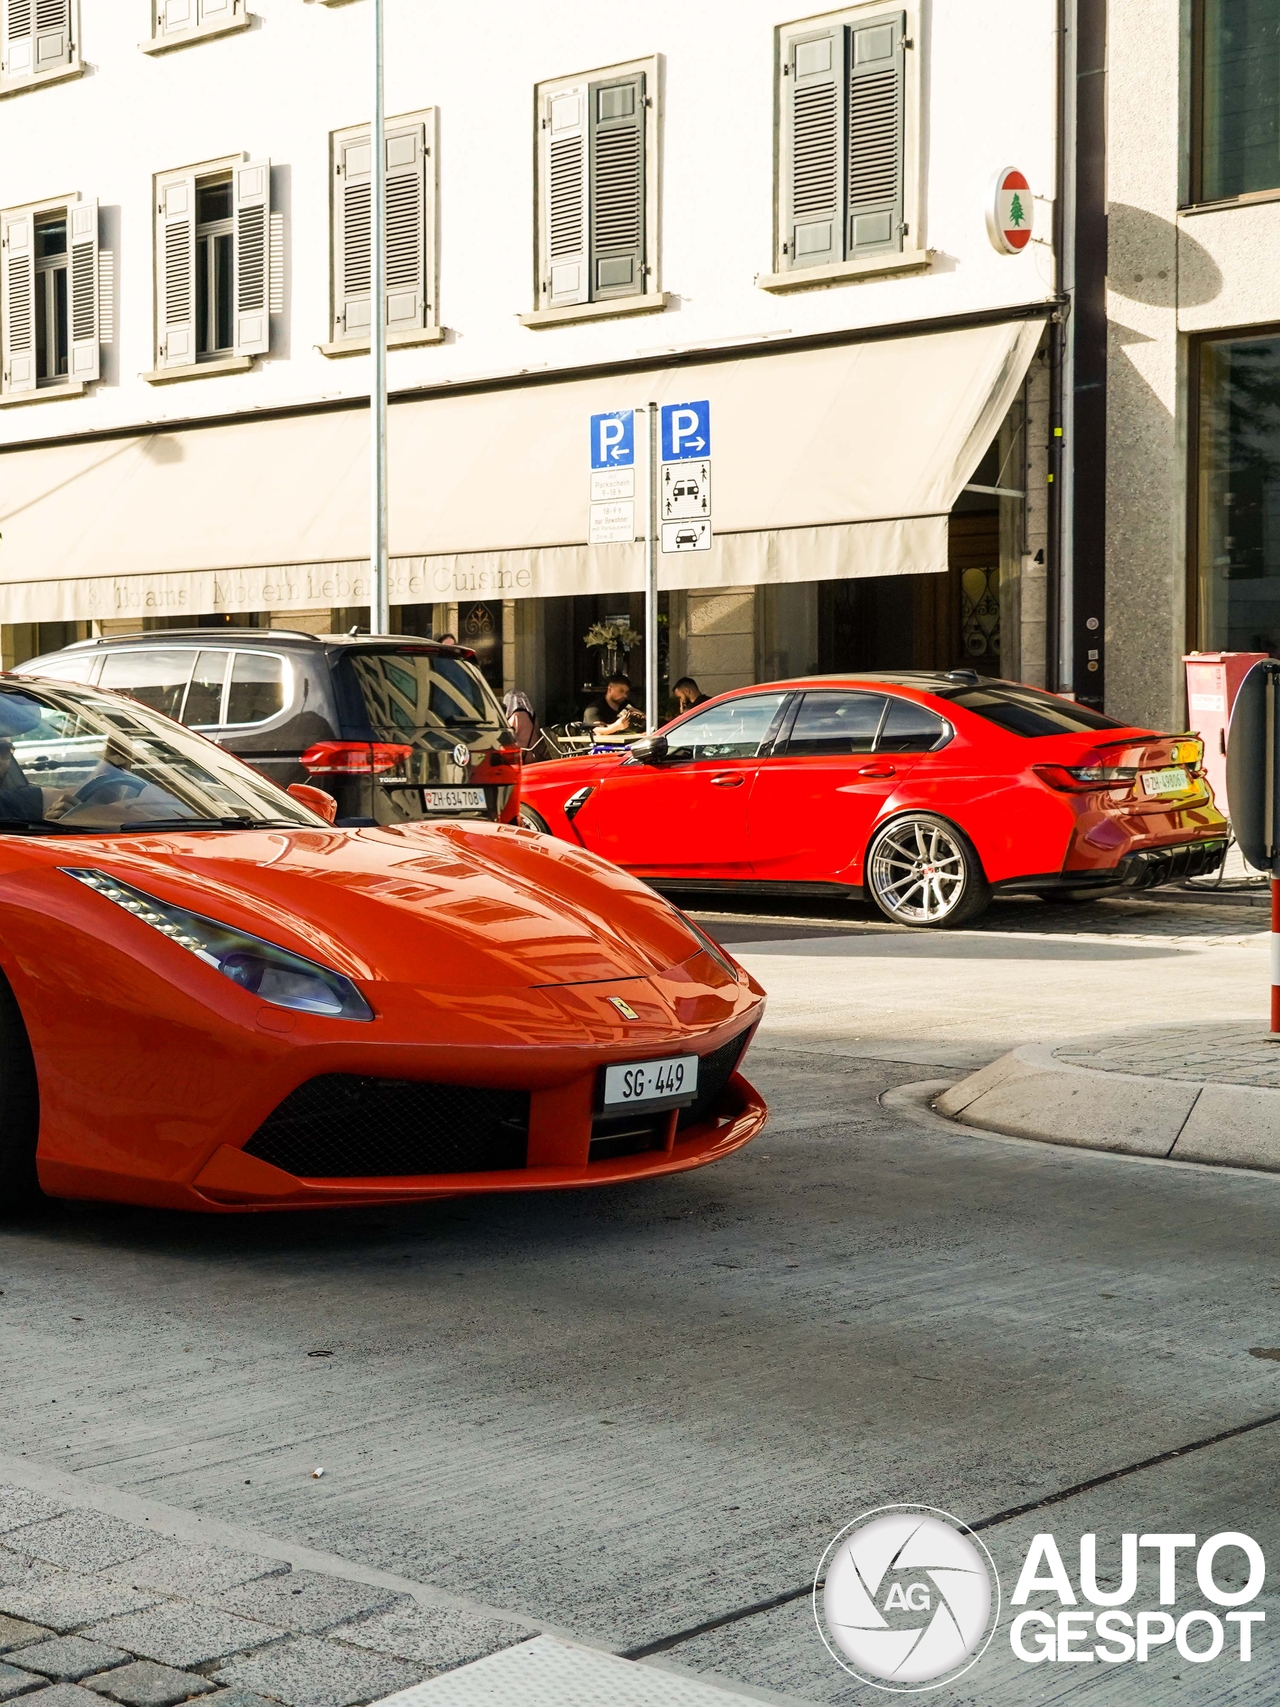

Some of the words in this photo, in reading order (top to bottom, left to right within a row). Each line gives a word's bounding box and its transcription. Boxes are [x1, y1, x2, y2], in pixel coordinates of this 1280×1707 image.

[599, 418, 625, 462] P
[671, 409, 699, 454] P
[595, 479, 630, 489] Parkschein
[604, 516, 628, 524] Bewohner
[1033, 548, 1045, 565] 4
[213, 577, 301, 604] Modern
[307, 572, 423, 599] Lebaese
[433, 565, 532, 593] Cuisine
